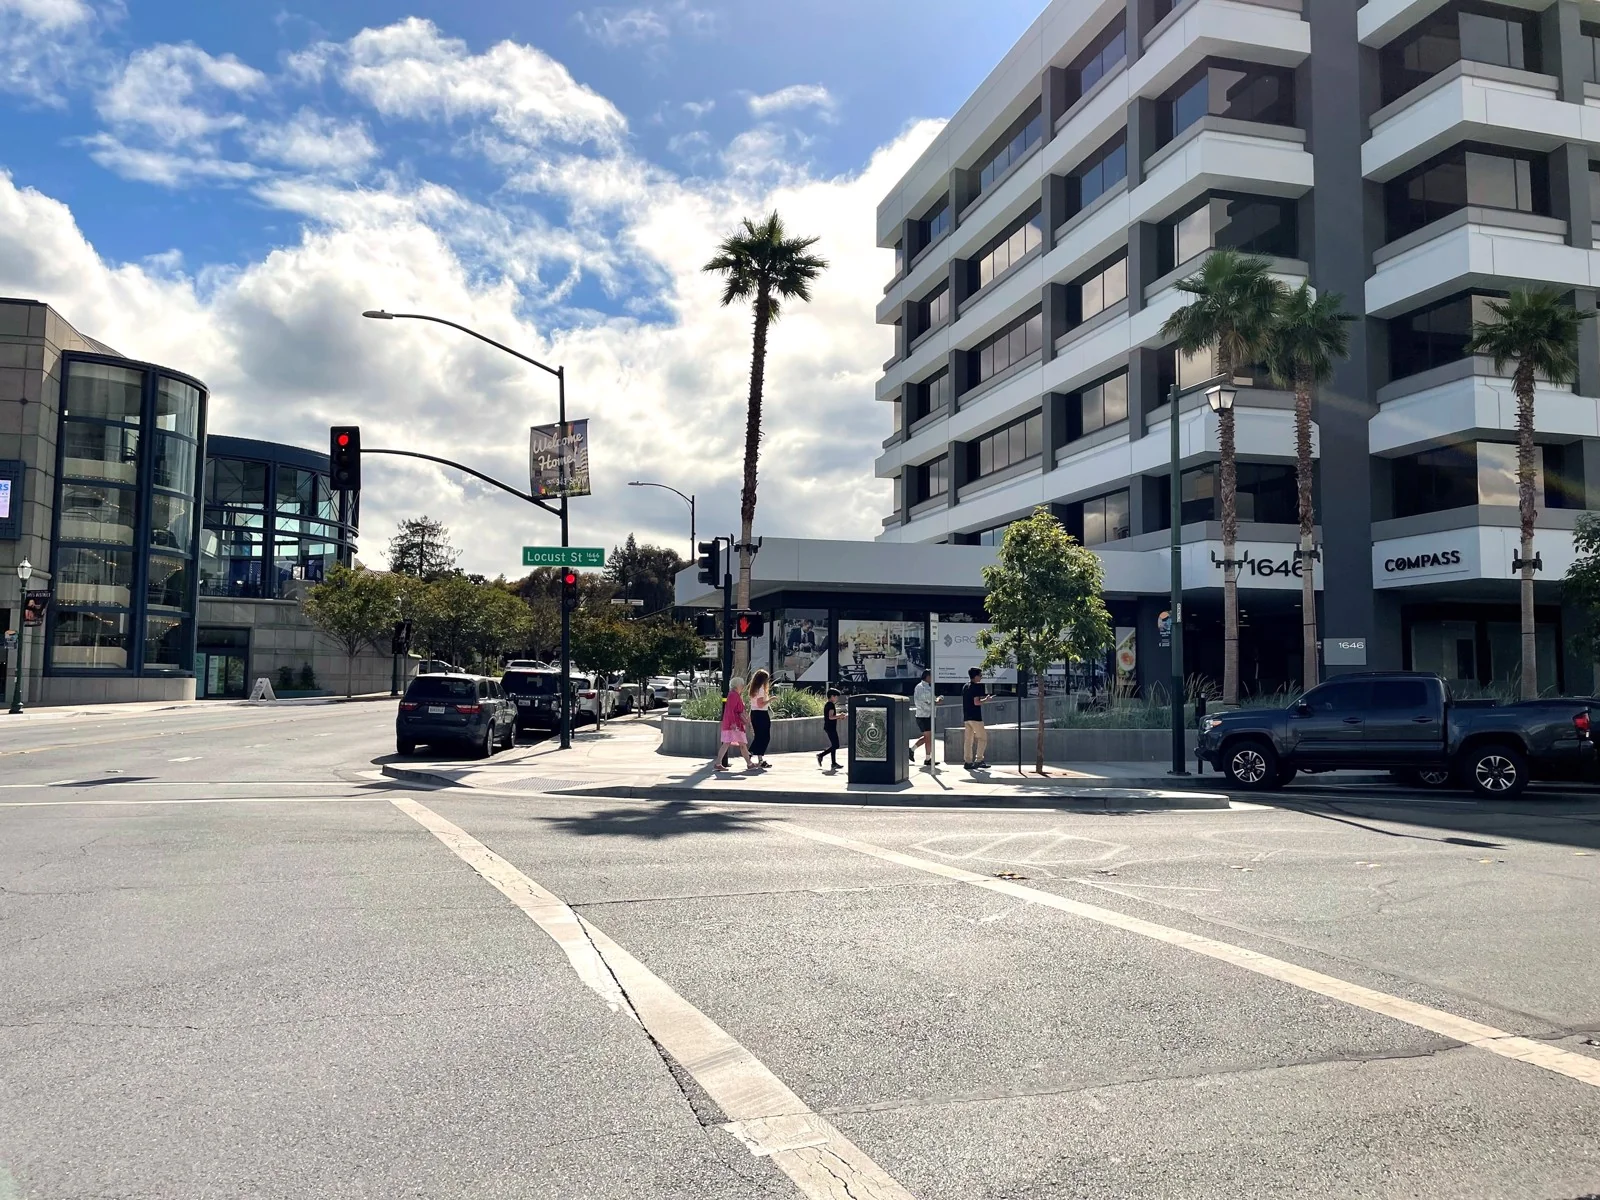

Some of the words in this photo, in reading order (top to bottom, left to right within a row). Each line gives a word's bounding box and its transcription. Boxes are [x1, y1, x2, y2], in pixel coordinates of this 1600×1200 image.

[533, 432, 584, 454] Welcome
[538, 446, 578, 472] Home!
[527, 551, 566, 562] Locust
[570, 552, 583, 563] St
[1384, 550, 1461, 573] COMPASS
[1247, 558, 1303, 577] 1646
[1338, 641, 1364, 649] 1646
